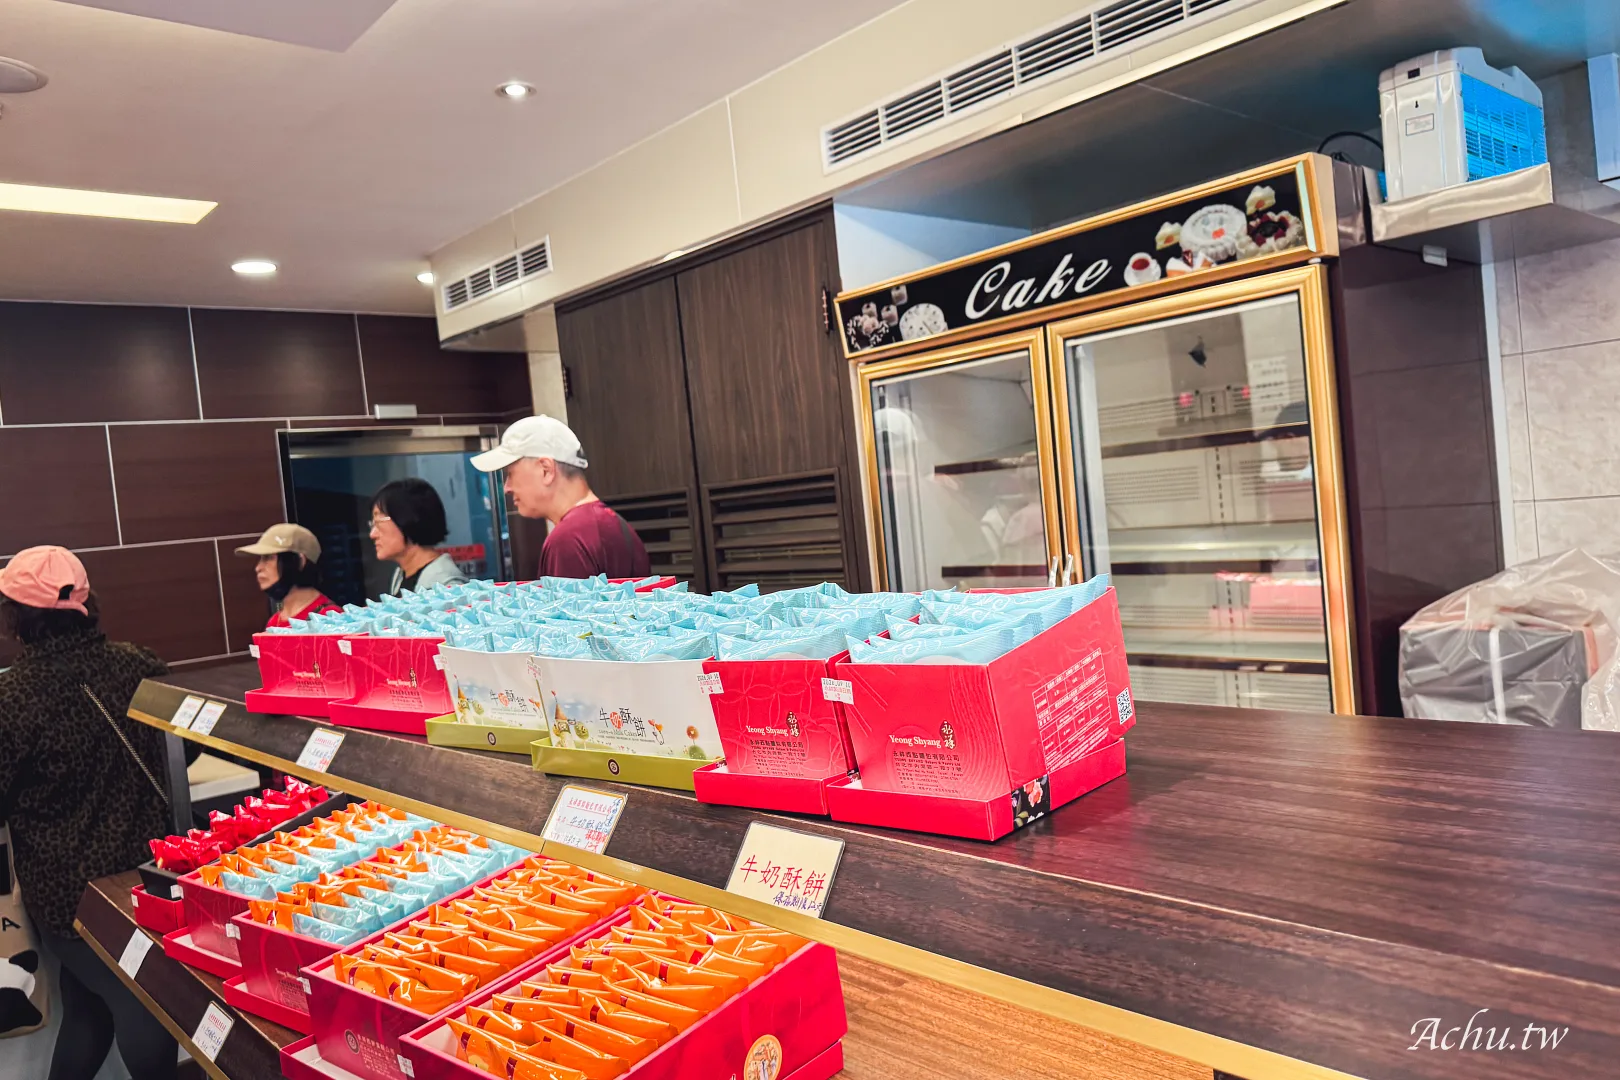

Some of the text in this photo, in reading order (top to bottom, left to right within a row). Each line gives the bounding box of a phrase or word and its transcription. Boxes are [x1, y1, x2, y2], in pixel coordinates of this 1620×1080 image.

[964, 252, 1113, 320] Cake
[746, 725, 766, 736] Yeong
[889, 734, 942, 749] Yeong Shyang
[740, 854, 826, 902] 牛奶酥餅
